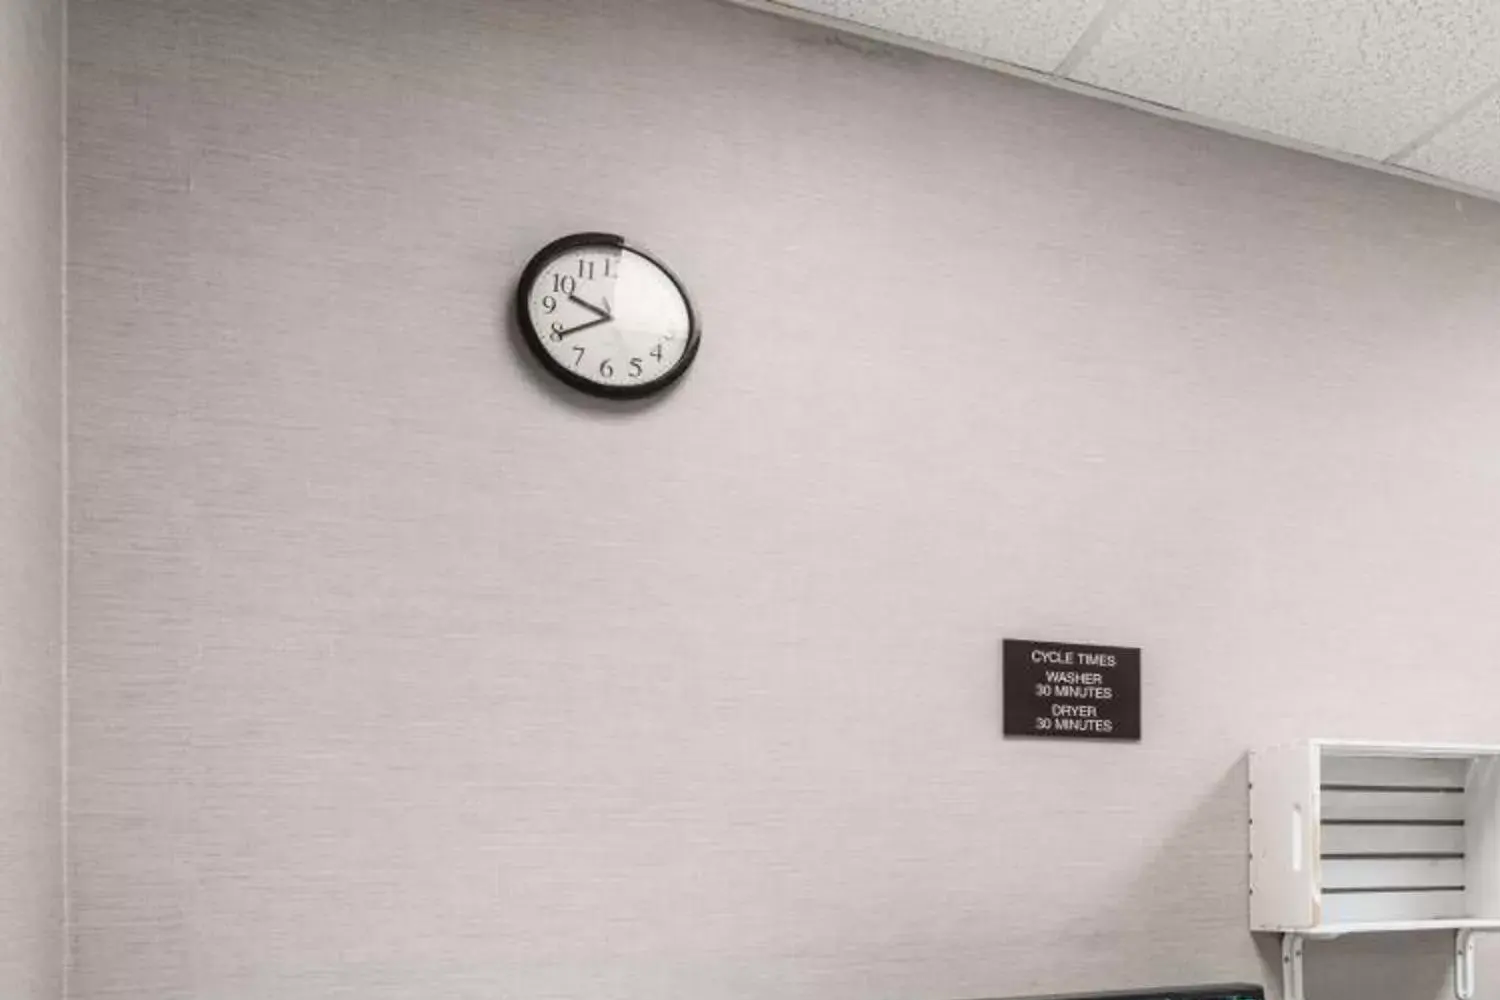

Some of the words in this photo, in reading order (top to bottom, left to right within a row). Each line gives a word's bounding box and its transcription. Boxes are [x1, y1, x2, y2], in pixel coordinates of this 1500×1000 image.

[578, 259, 595, 281] 11
[552, 273, 576, 295] 10
[542, 295, 557, 314] 9
[550, 320, 564, 342] 8
[572, 346, 586, 366] 7
[650, 343, 662, 362] 4
[600, 358, 614, 378] 6
[628, 357, 644, 377] 5
[1031, 650, 1073, 664] CYCLE
[1077, 653, 1116, 667] TIMES
[1045, 671, 1102, 684] WASHER
[1035, 683, 1052, 697] 30
[1054, 685, 1112, 699] MINUTES
[1051, 704, 1097, 717] DRYER
[1035, 717, 1052, 730] 30
[1054, 718, 1112, 732] MINUTES
